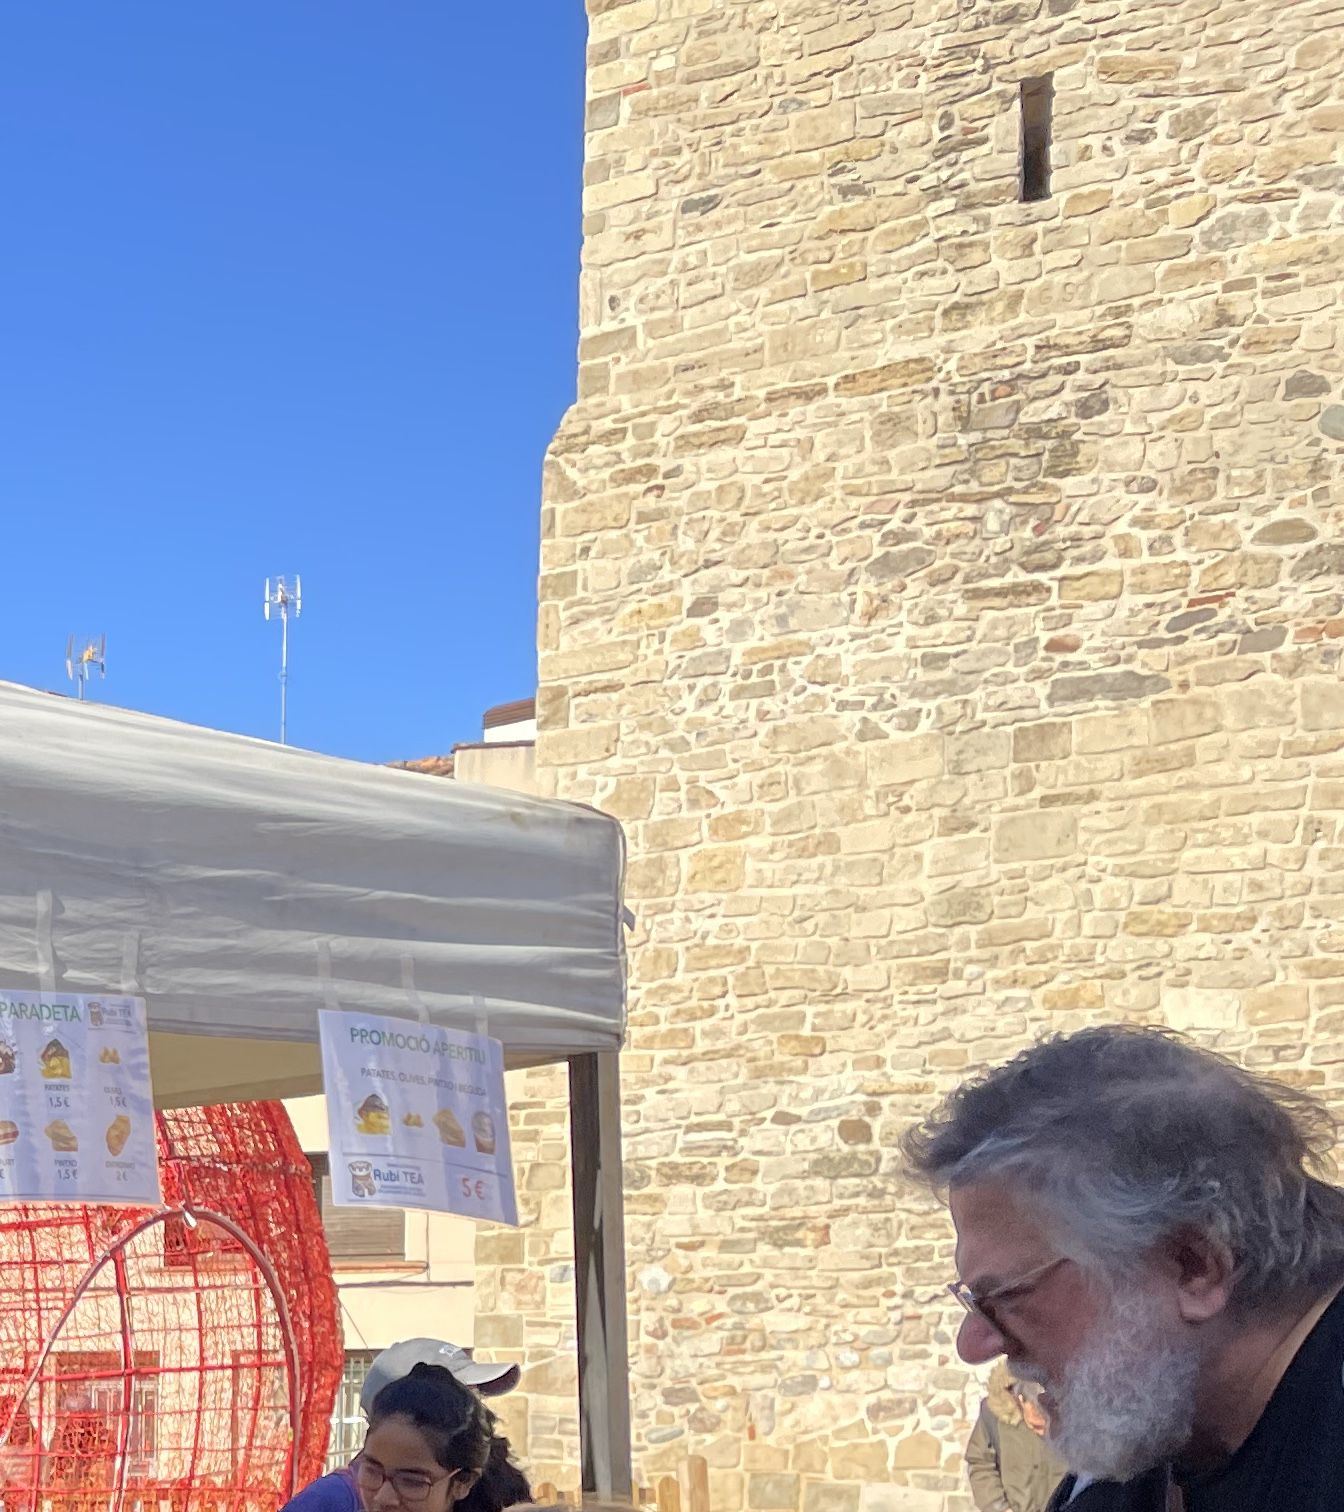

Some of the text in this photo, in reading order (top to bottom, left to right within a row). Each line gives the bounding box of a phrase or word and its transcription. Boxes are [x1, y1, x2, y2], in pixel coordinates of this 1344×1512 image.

[0, 1001, 82, 1023] PARADETA
[350, 1027, 486, 1065] PROMOCIÓ APERITIU
[49, 1096, 70, 1107] 1,5 €
[70, 1169, 78, 1180] €
[401, 1170, 424, 1185] TEA
[461, 1175, 486, 1201] 5 €
